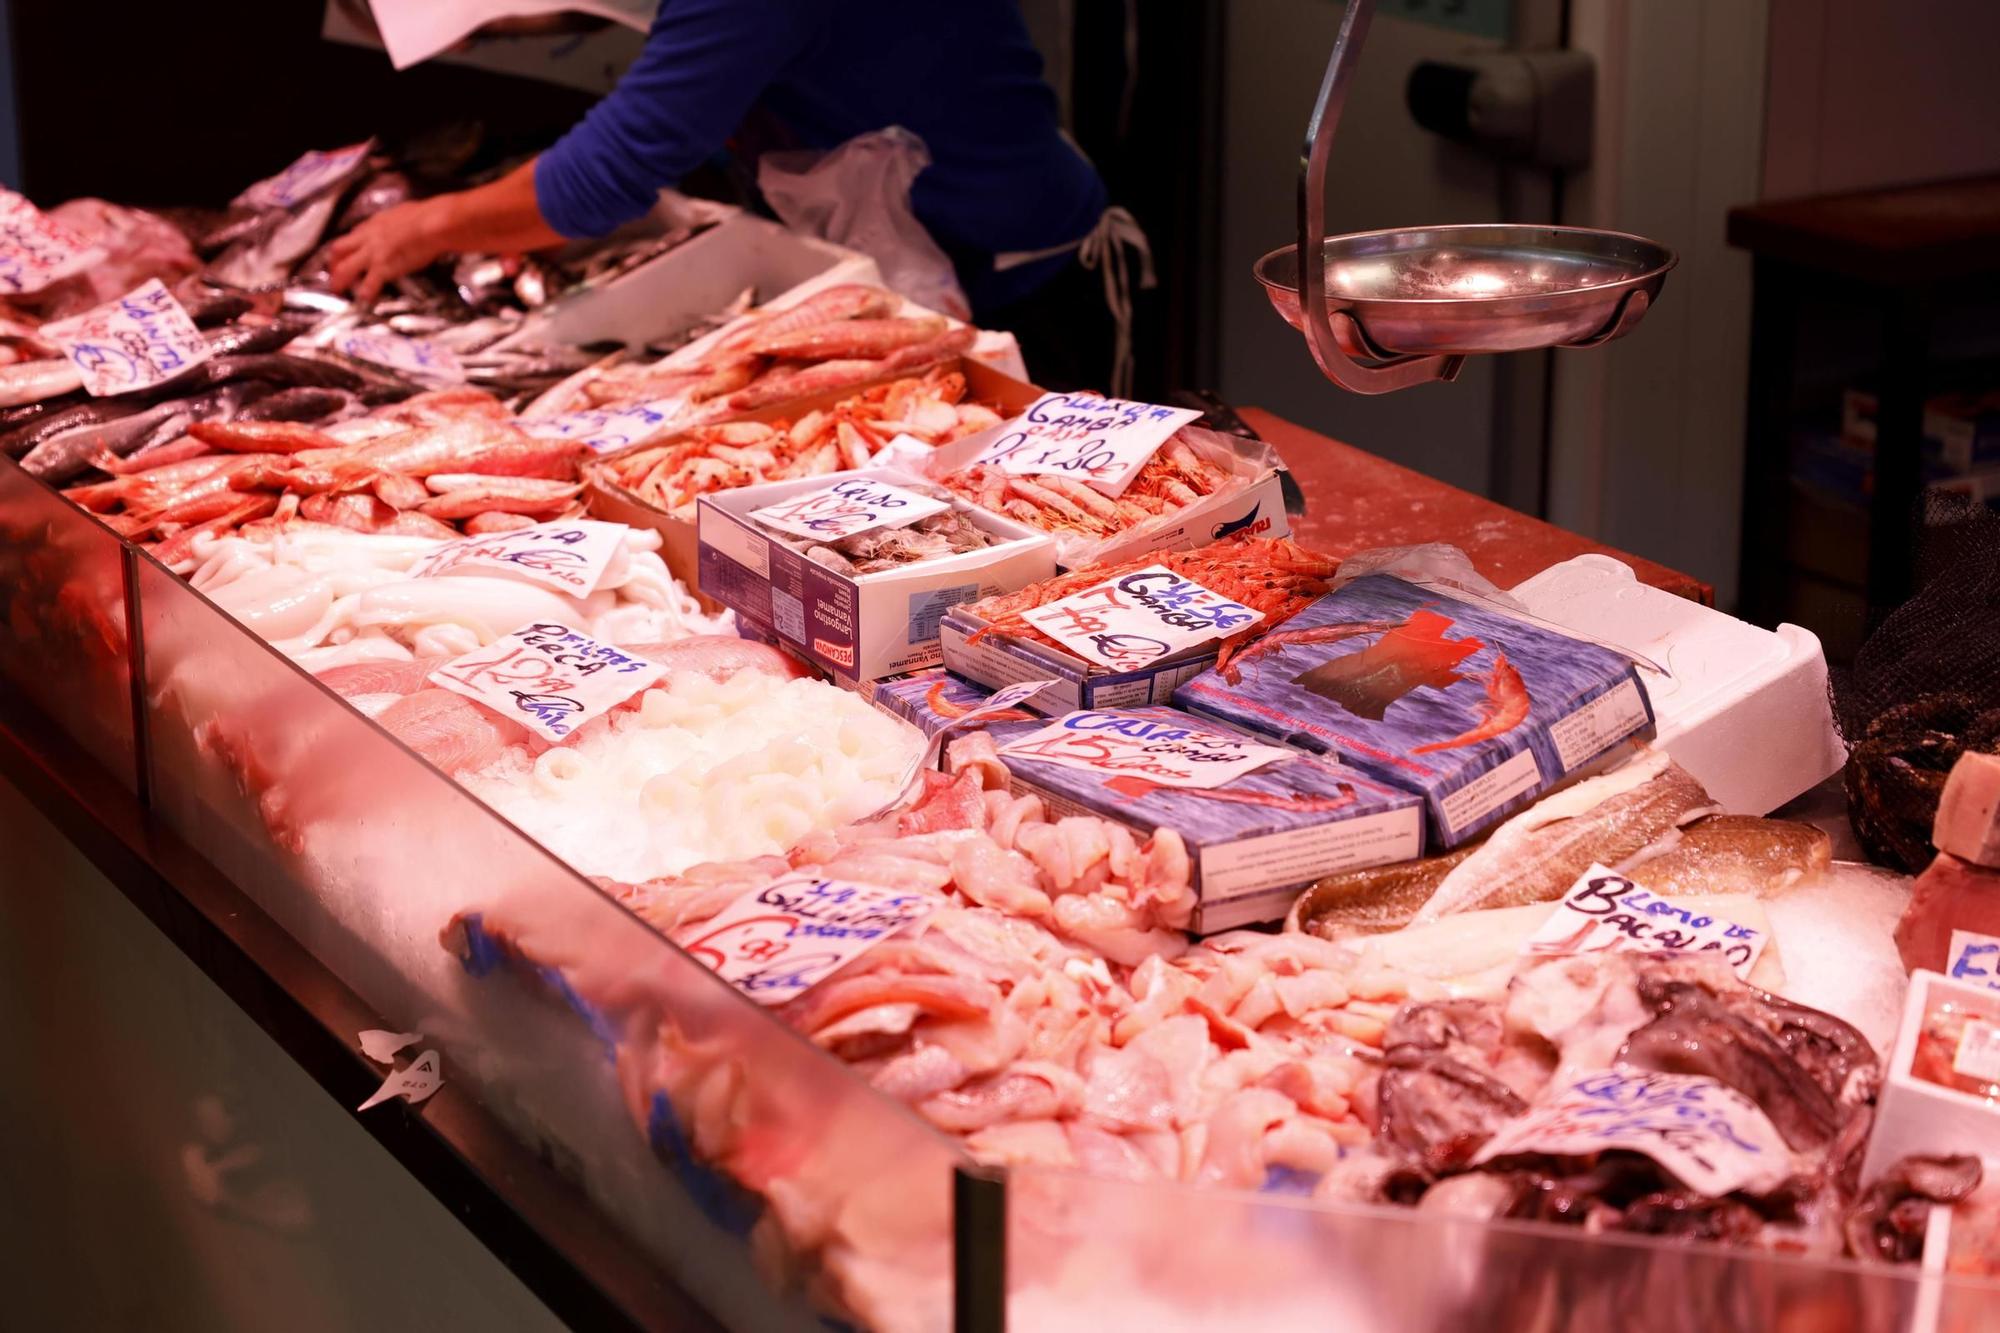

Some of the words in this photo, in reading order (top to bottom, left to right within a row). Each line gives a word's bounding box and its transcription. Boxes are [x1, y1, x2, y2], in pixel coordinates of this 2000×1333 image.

[832, 479, 908, 508] CRUDO
[817, 598, 852, 627] Vannamei
[1118, 573, 1213, 632] GAMBA
[813, 609, 853, 640] Langostino
[513, 624, 607, 677] PERCA
[815, 640, 853, 663] PESCANOVA
[1064, 714, 1195, 741] CAJA
